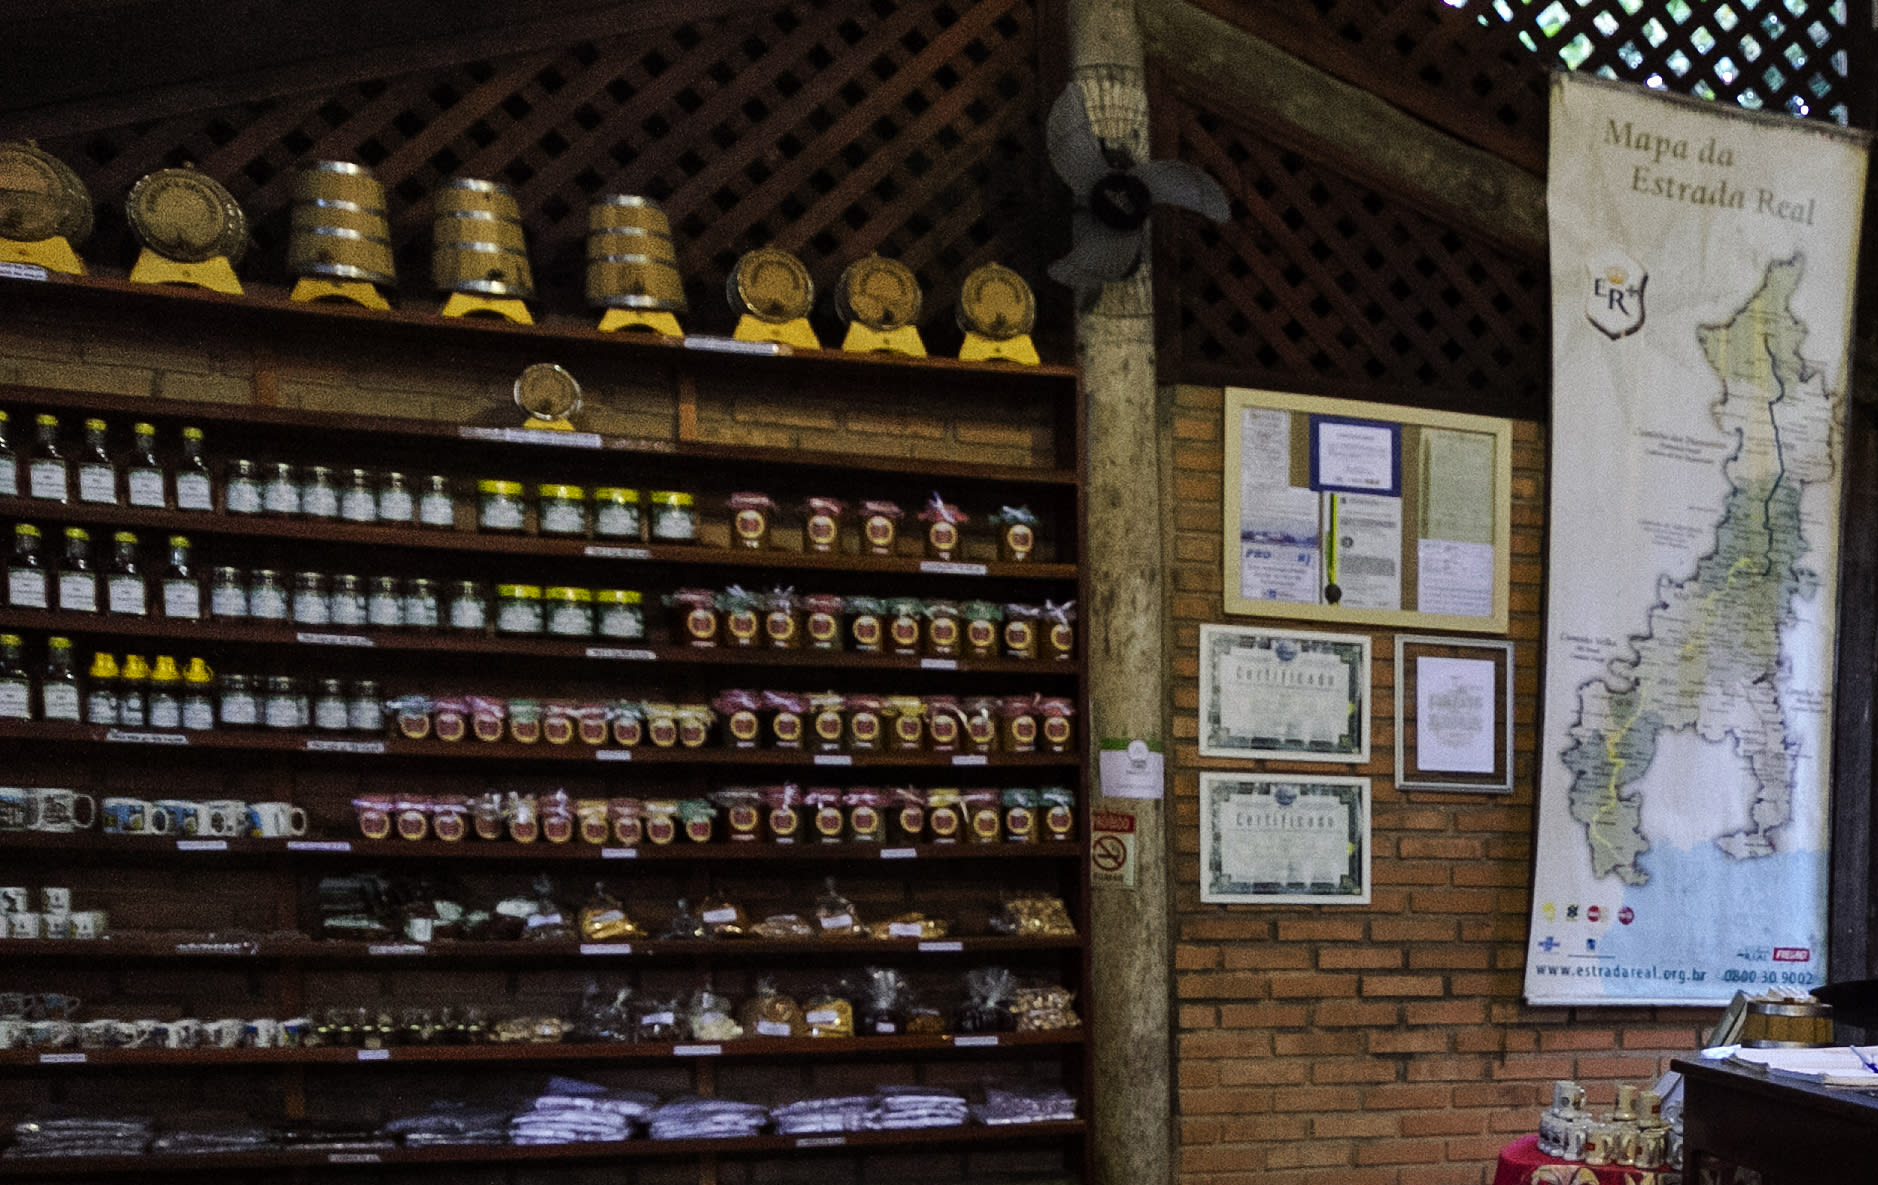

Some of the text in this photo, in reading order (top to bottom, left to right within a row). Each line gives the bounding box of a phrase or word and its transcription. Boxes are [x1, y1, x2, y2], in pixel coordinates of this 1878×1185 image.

[1604, 118, 1734, 168] Mapa da
[1632, 165, 1815, 225] Estrada Real
[1536, 963, 1707, 984] www.estradareal.org.br
[1724, 969, 1814, 985] 0800 30 9002
